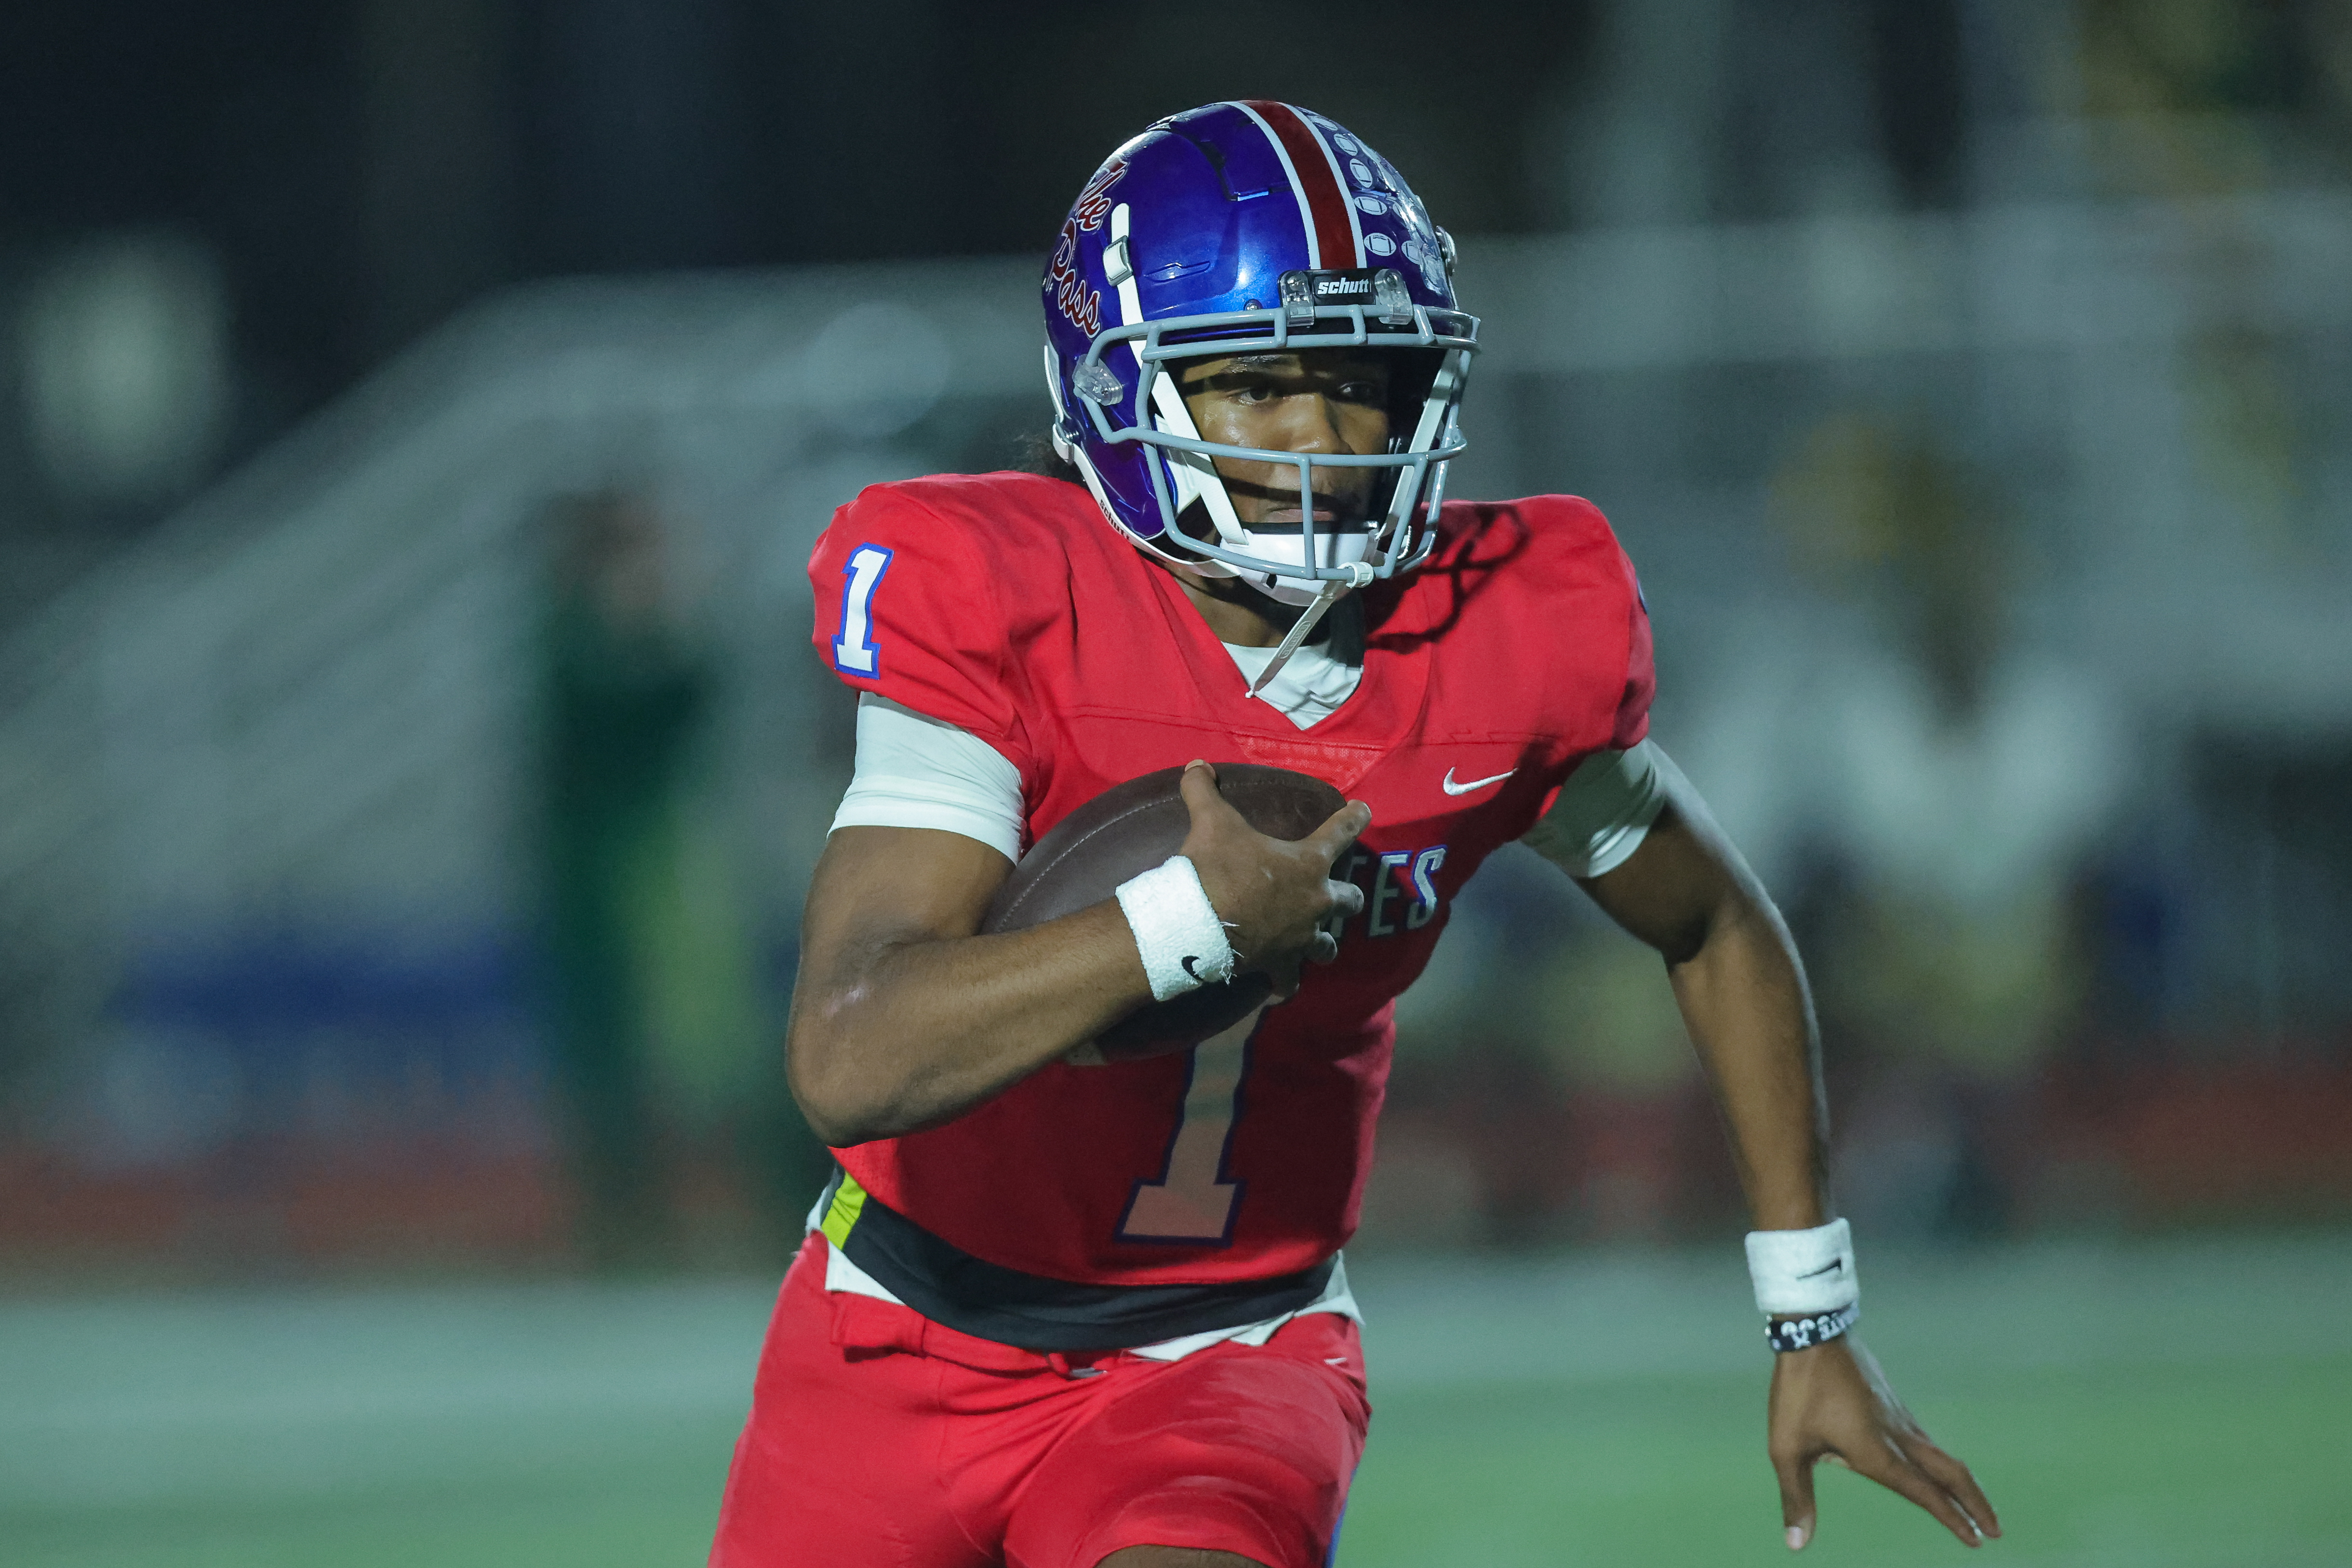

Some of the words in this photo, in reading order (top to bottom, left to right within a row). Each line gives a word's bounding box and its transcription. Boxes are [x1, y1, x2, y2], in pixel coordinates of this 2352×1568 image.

[1045, 217, 1101, 338] Pass
[1317, 277, 1369, 295] schutt
[831, 542, 895, 680] 1
[1113, 993, 1286, 1249] 1
